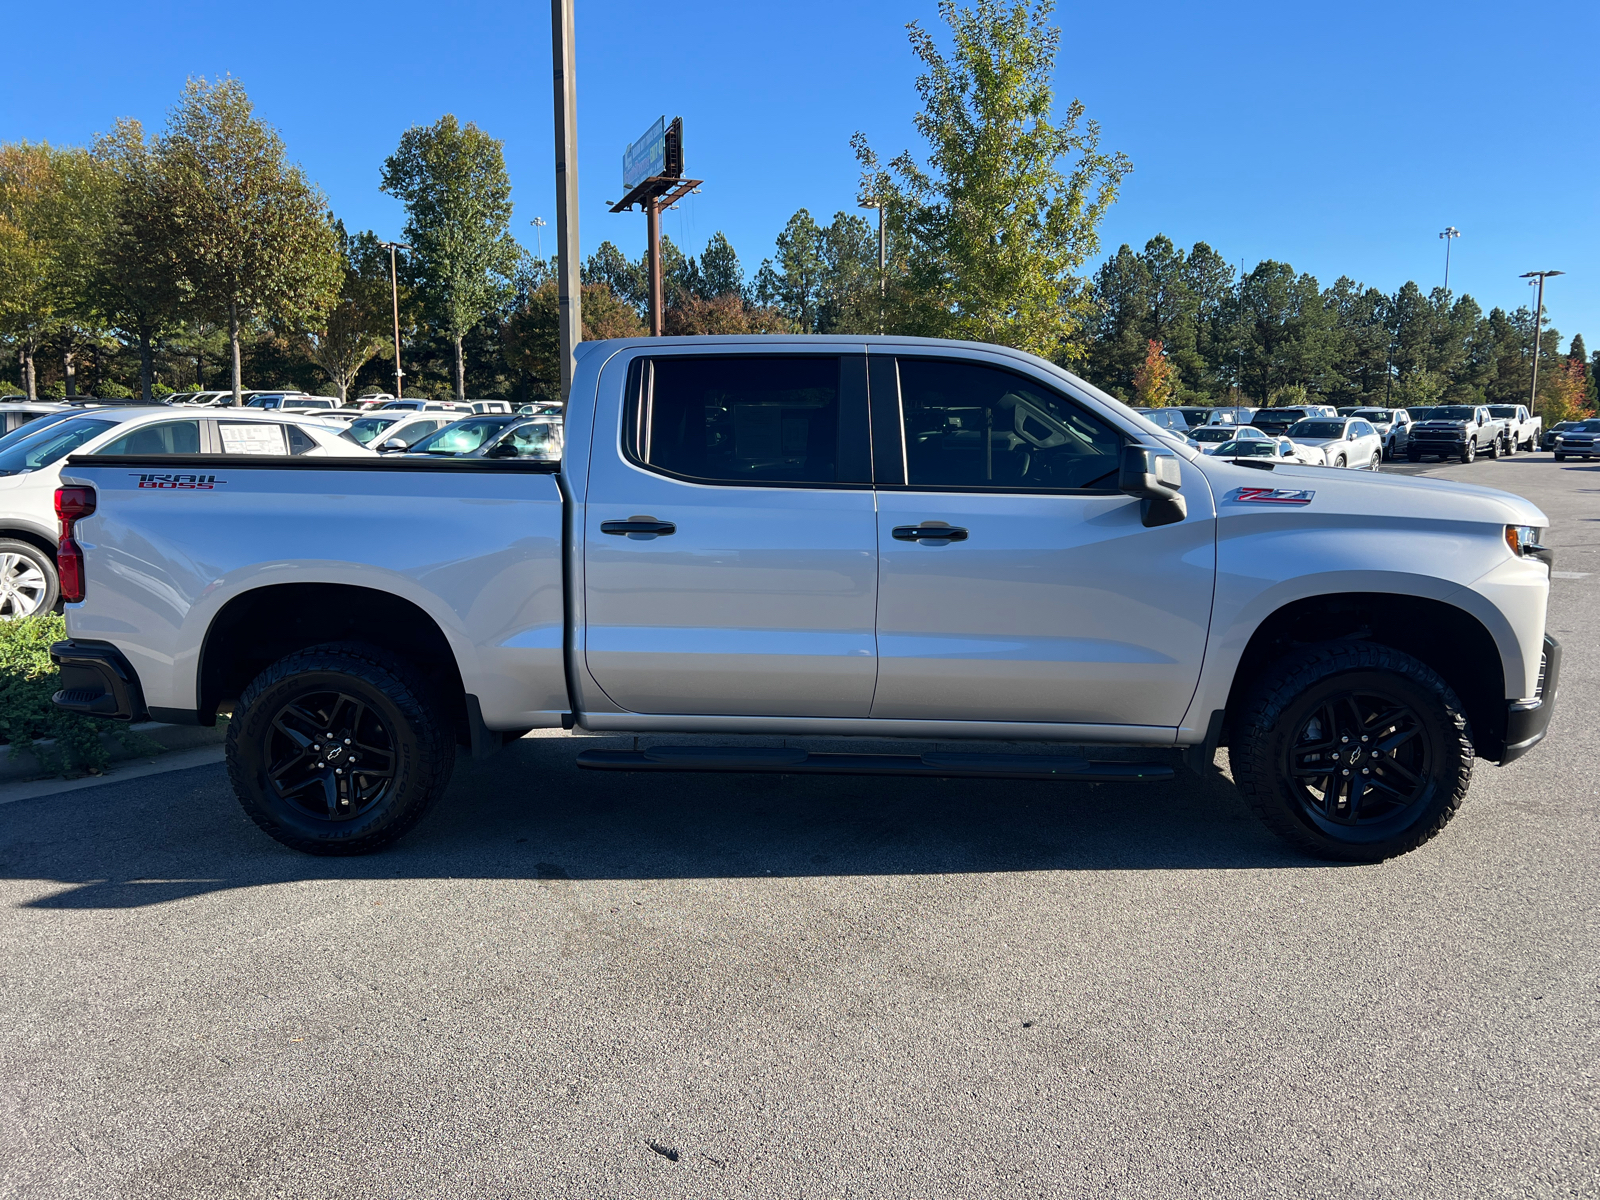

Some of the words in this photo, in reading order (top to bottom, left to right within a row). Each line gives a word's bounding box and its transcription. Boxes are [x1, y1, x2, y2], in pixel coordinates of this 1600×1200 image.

[128, 473, 227, 483] TRAIL
[1236, 486, 1316, 503] Z71
[247, 679, 299, 737] COOPER
[361, 743, 411, 832] DISCOVERER
